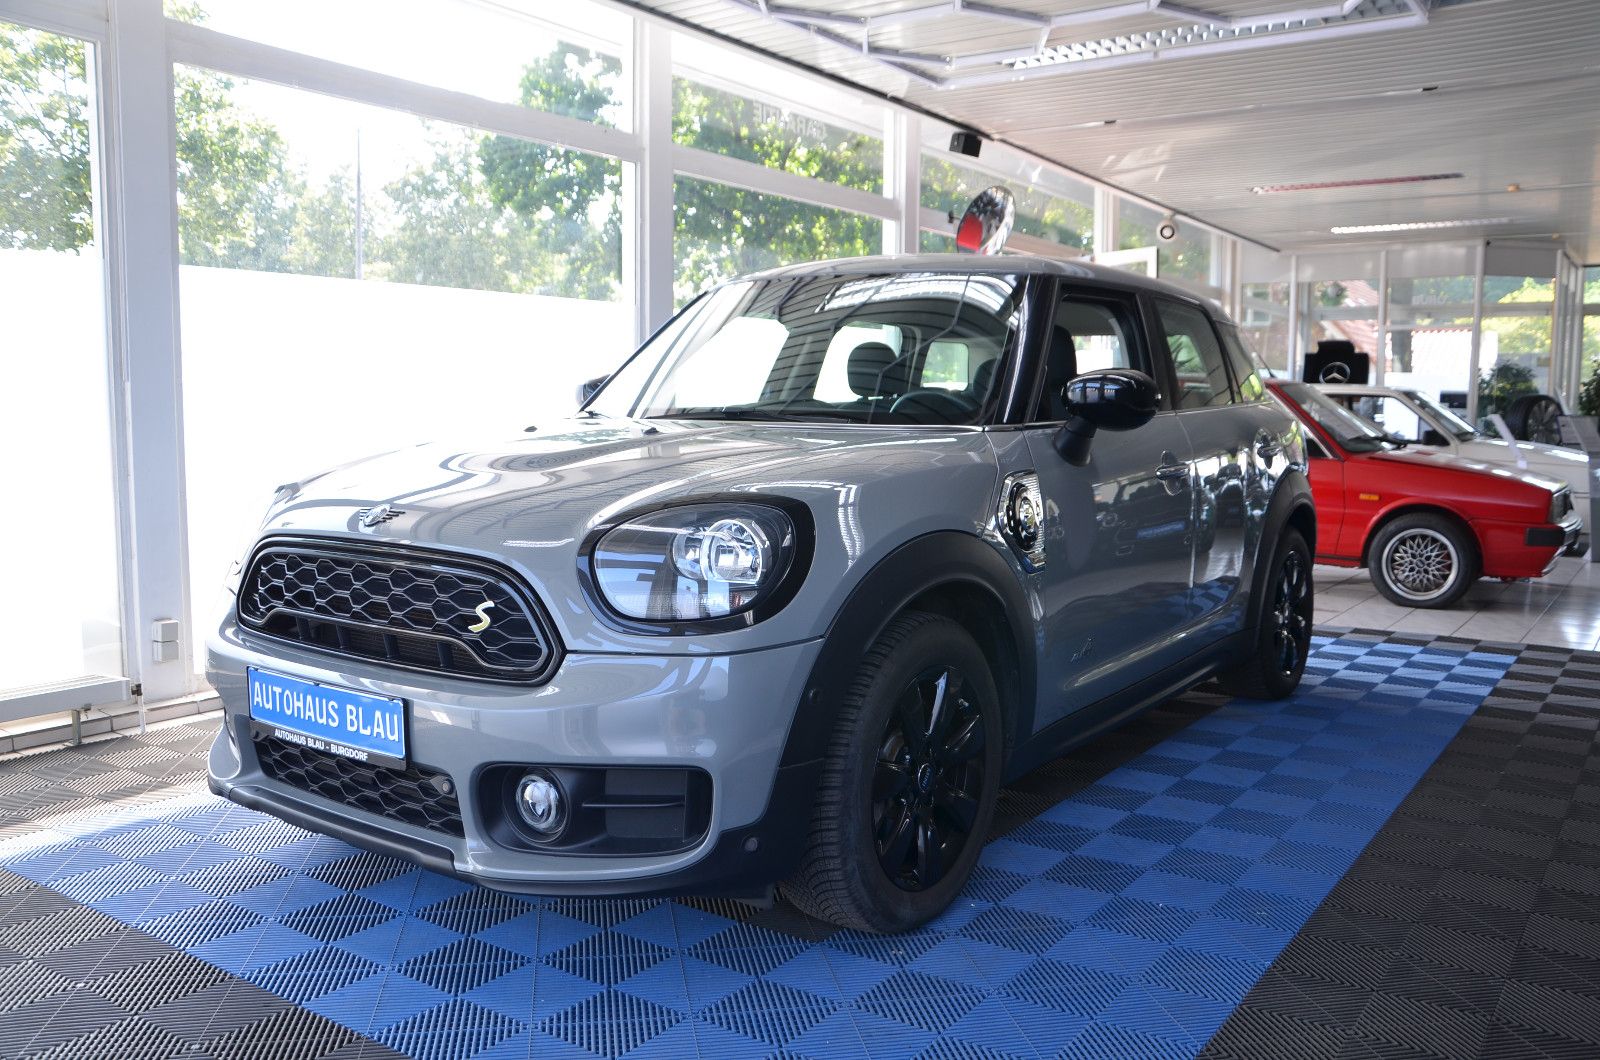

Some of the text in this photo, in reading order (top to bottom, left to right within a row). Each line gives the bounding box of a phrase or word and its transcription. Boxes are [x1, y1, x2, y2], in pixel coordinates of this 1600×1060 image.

[468, 600, 495, 633] S
[253, 681, 399, 742] AUTOHAUS BLAU
[274, 728, 306, 746] AUTOHAUS
[307, 737, 325, 750] BLAU
[330, 744, 369, 762] BURGDORF
